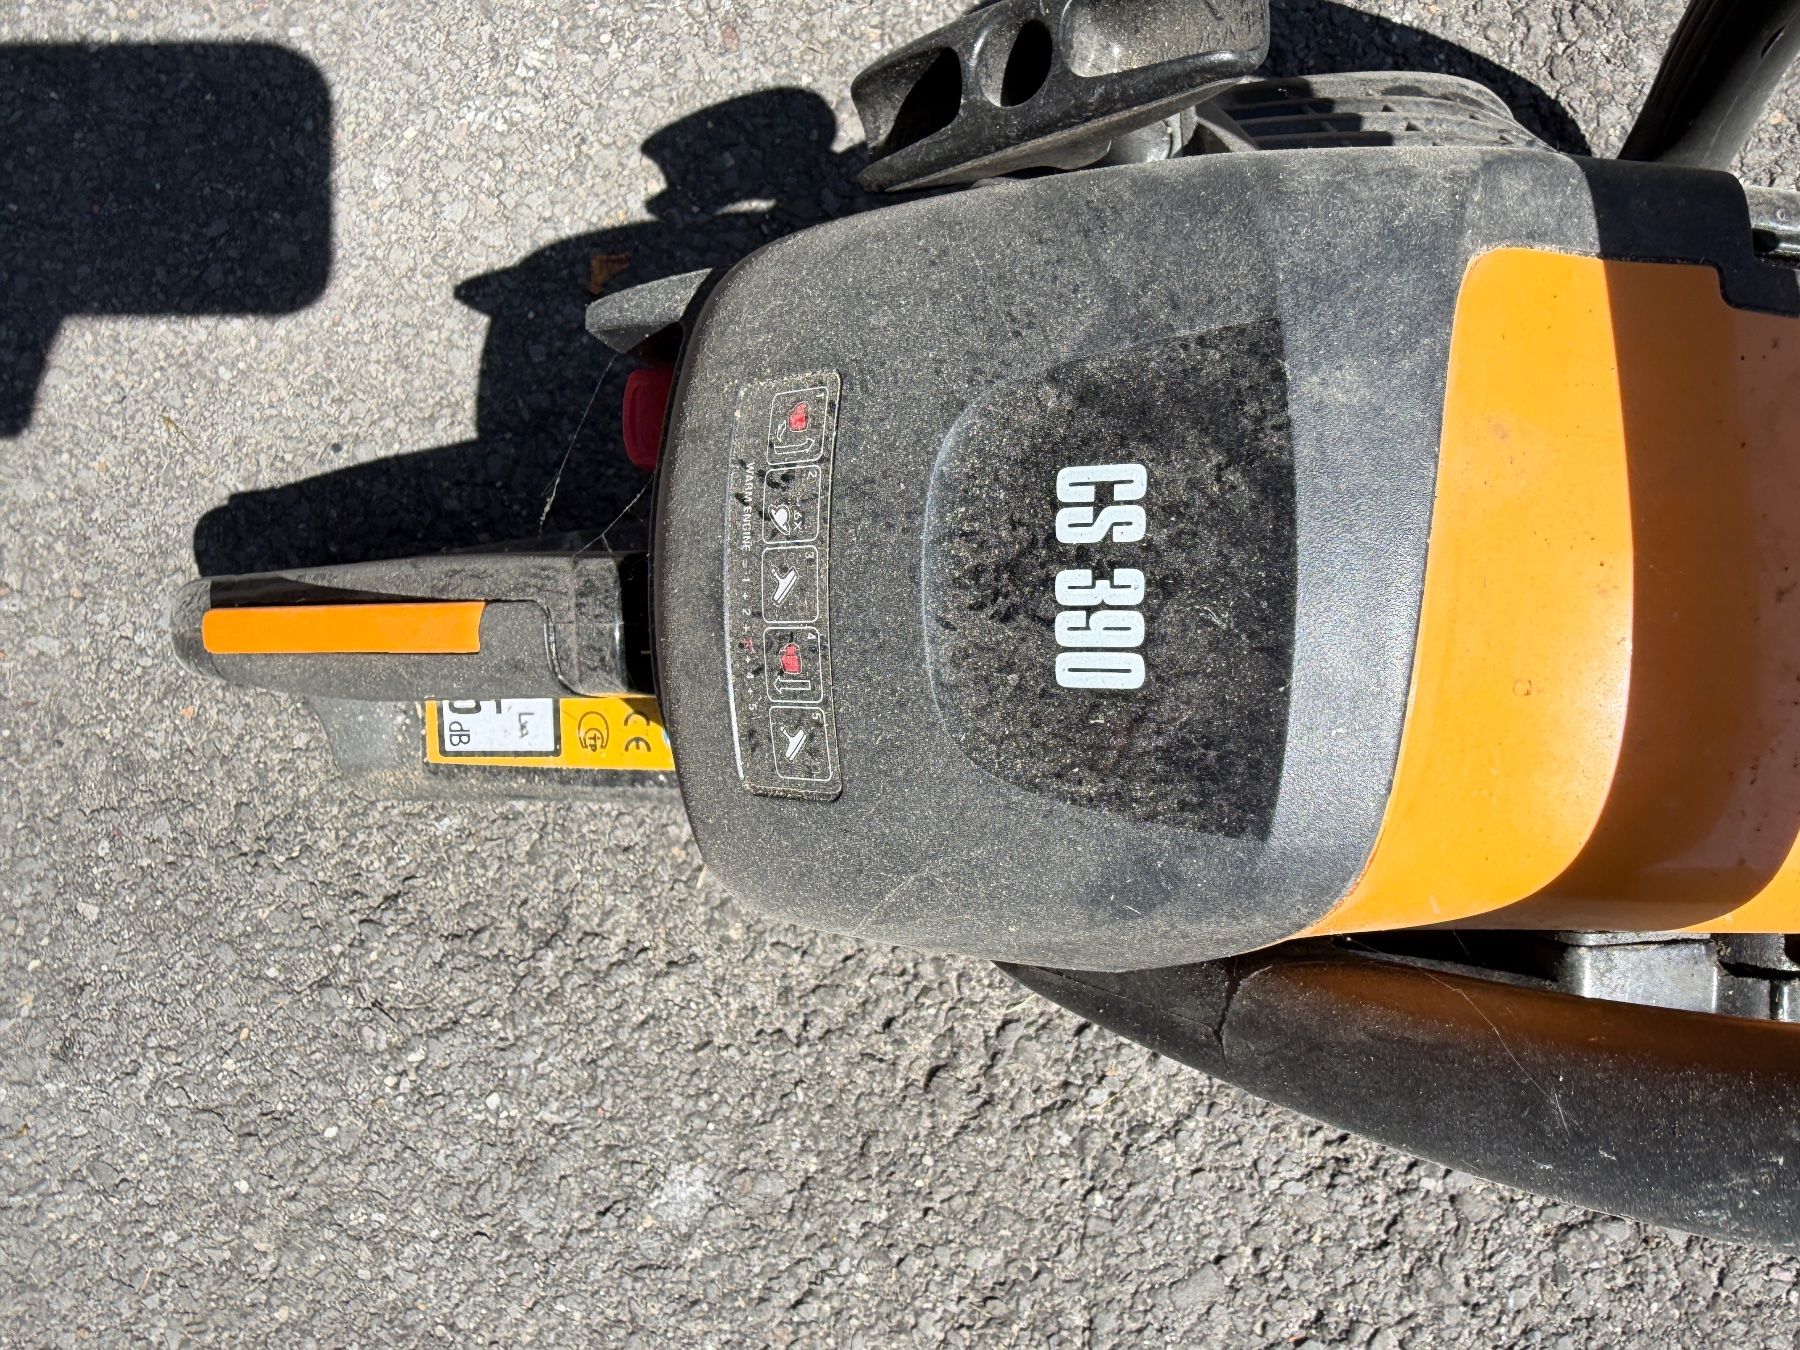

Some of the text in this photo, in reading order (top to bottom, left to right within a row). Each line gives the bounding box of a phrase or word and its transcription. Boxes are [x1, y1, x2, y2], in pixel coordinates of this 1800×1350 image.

[743, 461, 755, 500] WARM
[807, 471, 817, 480] 2
[741, 507, 752, 552] ENGINE
[804, 551, 815, 559] 3
[1054, 463, 1148, 690] CS 390
[807, 632, 817, 640] 4
[448, 720, 471, 747] dB
